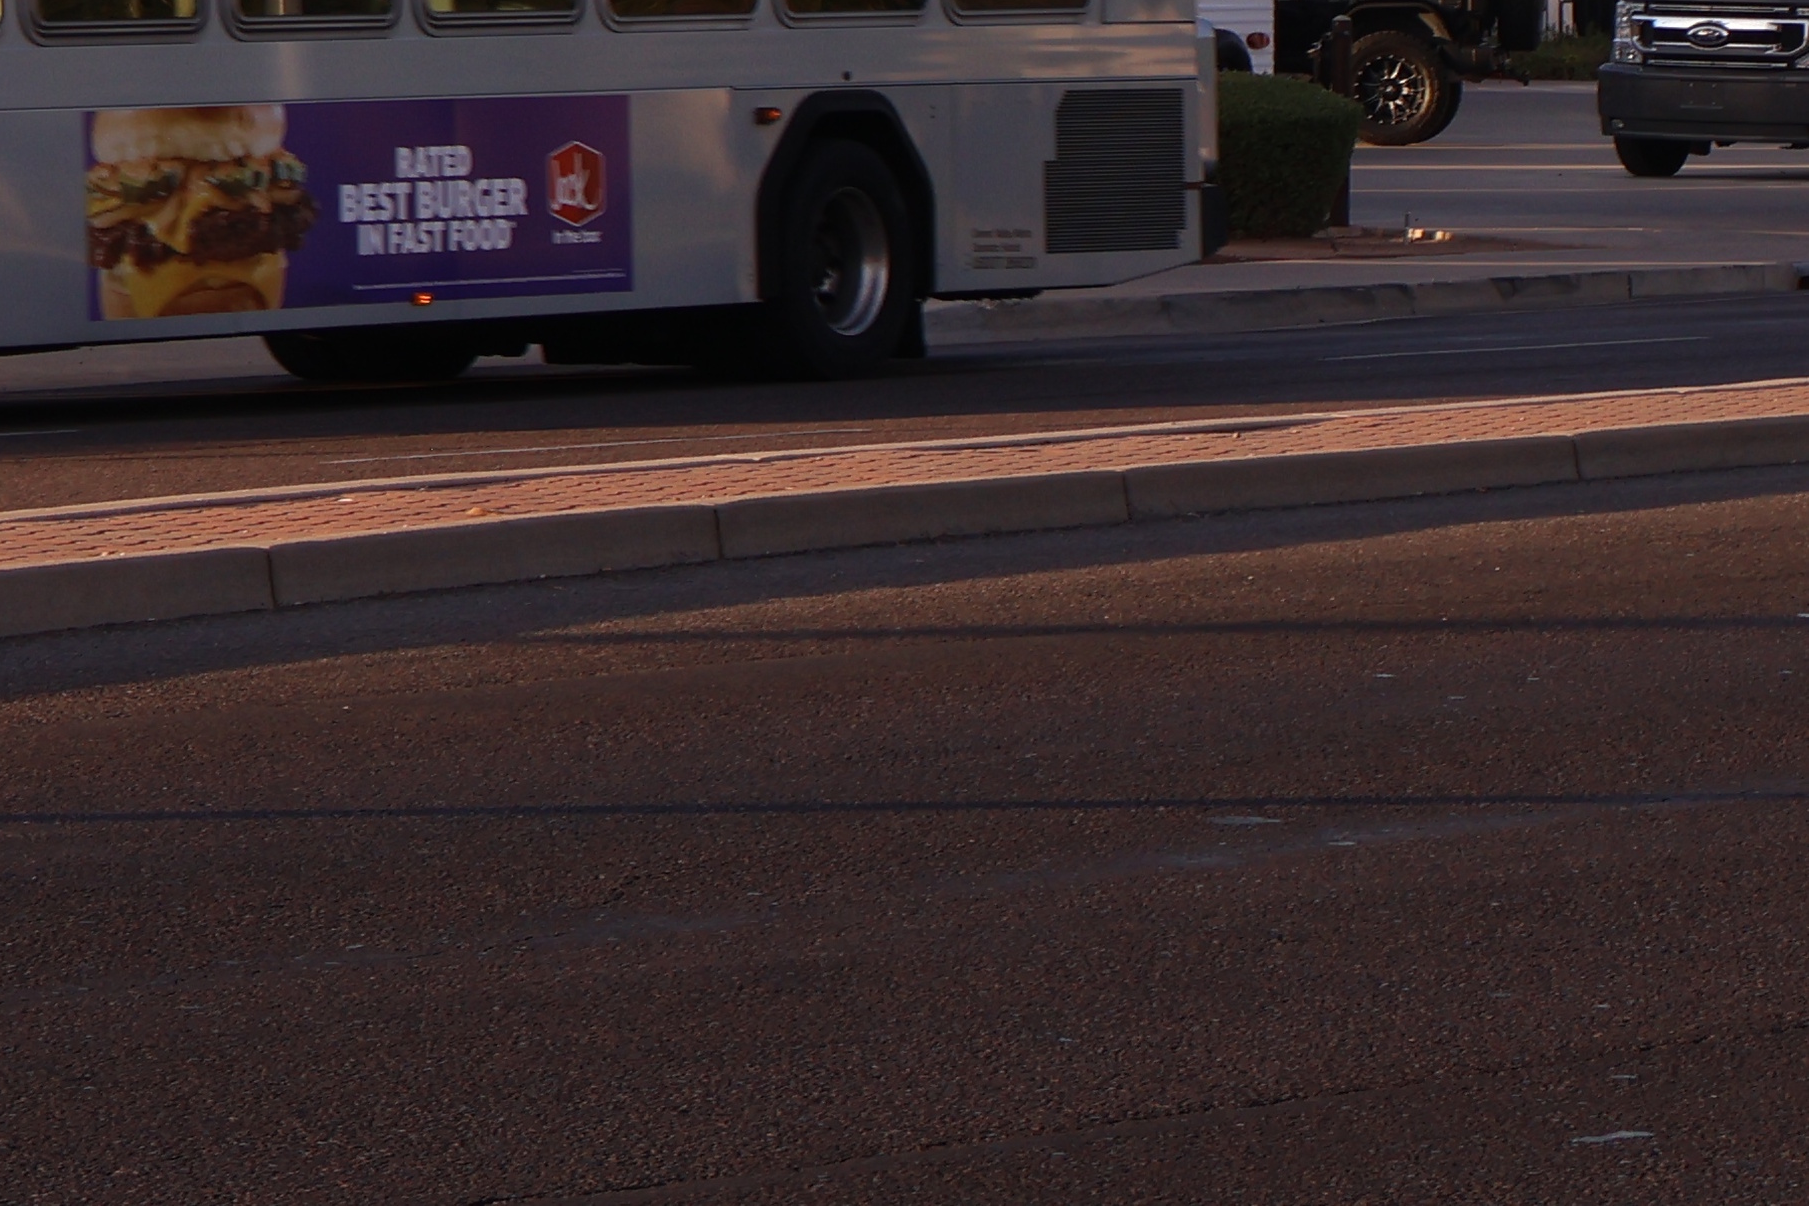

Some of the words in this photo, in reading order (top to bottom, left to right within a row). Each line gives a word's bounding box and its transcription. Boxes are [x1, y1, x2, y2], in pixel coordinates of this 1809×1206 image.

[395, 145, 473, 178] RATED
[339, 181, 412, 222] BEST
[413, 178, 529, 219] BURGER
[357, 223, 386, 255] IN
[387, 221, 447, 254] FAST
